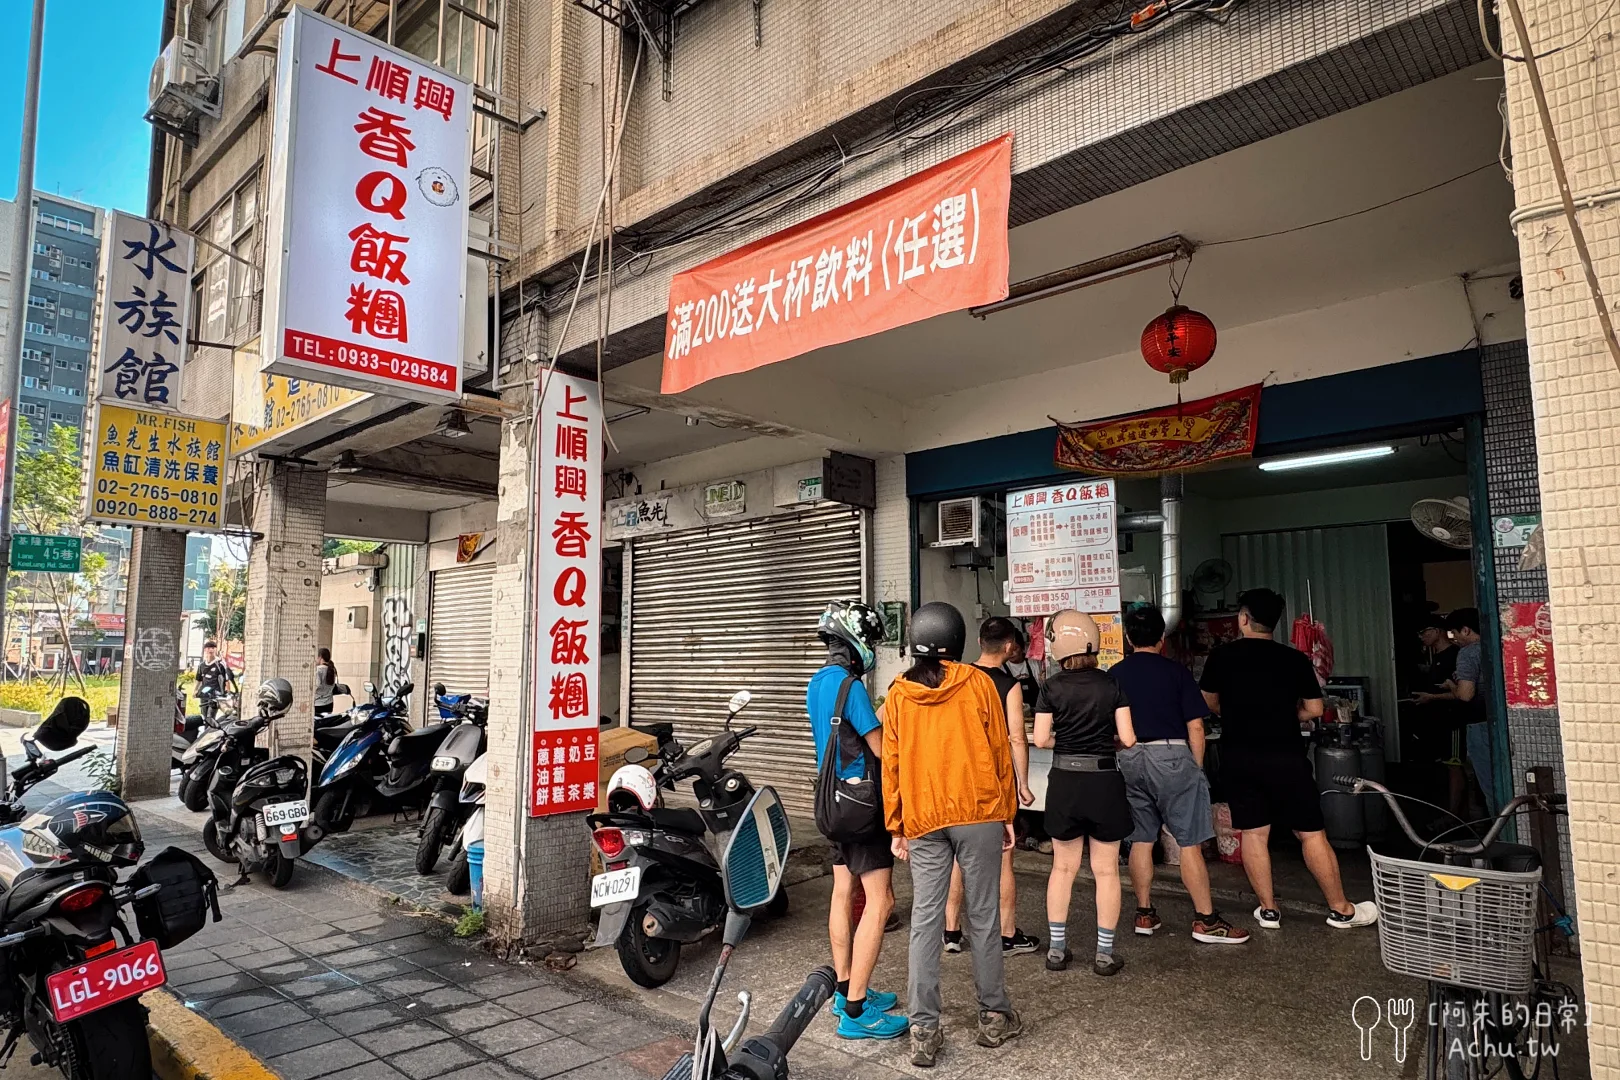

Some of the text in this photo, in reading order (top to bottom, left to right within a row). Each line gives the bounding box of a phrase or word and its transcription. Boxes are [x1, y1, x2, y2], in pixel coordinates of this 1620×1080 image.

[315, 38, 455, 122] 上順興
[344, 106, 417, 344] 香Q飯糰
[104, 223, 187, 404] 水族館
[103, 423, 221, 461] 魚先生水族館
[101, 451, 218, 486] 魚缸清洗保養
[97, 479, 218, 506] 02-2765-0810
[96, 499, 217, 525] 0920-888-274
[18, 536, 78, 548] 基隆路一段
[536, 748, 550, 806] 蔥油餅
[266, 806, 308, 823] 669-GBQ
[593, 875, 636, 900] NCW-0291
[54, 953, 159, 1010] LGL-9066
